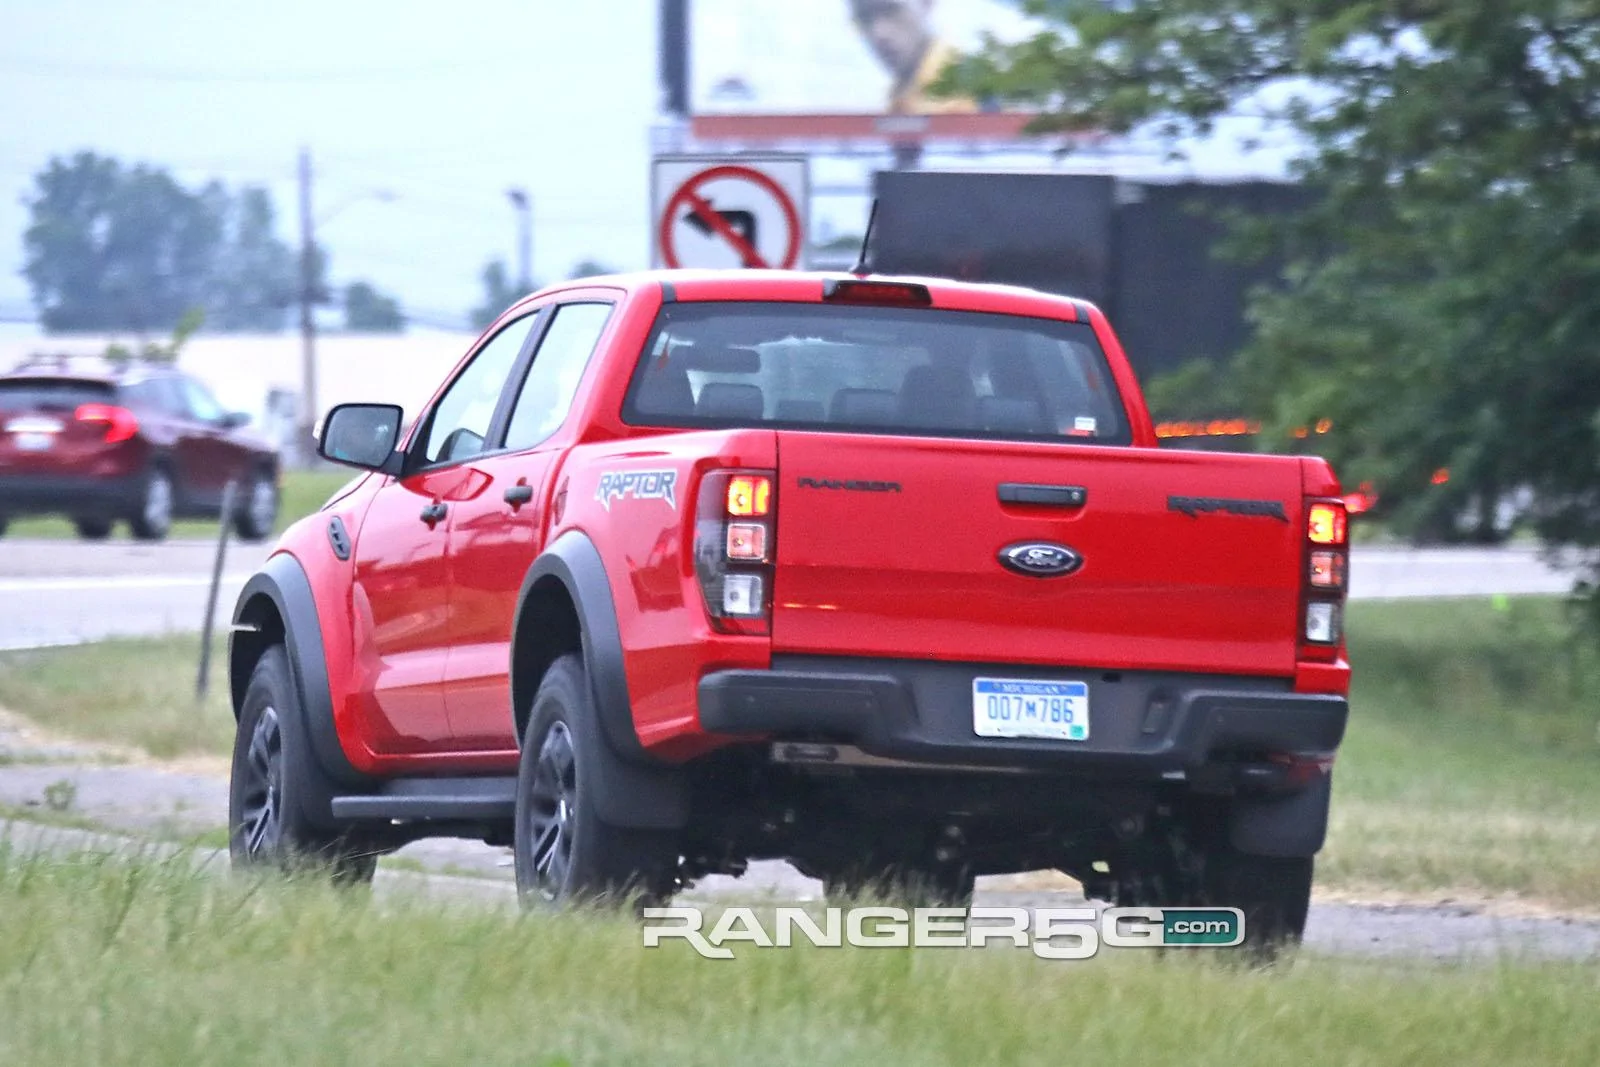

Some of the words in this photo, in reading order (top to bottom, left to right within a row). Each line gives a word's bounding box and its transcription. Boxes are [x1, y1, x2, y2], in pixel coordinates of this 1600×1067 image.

[594, 469, 678, 512] RAPTOR
[797, 477, 902, 493] RANGER
[1166, 495, 1290, 523] RAPTOR
